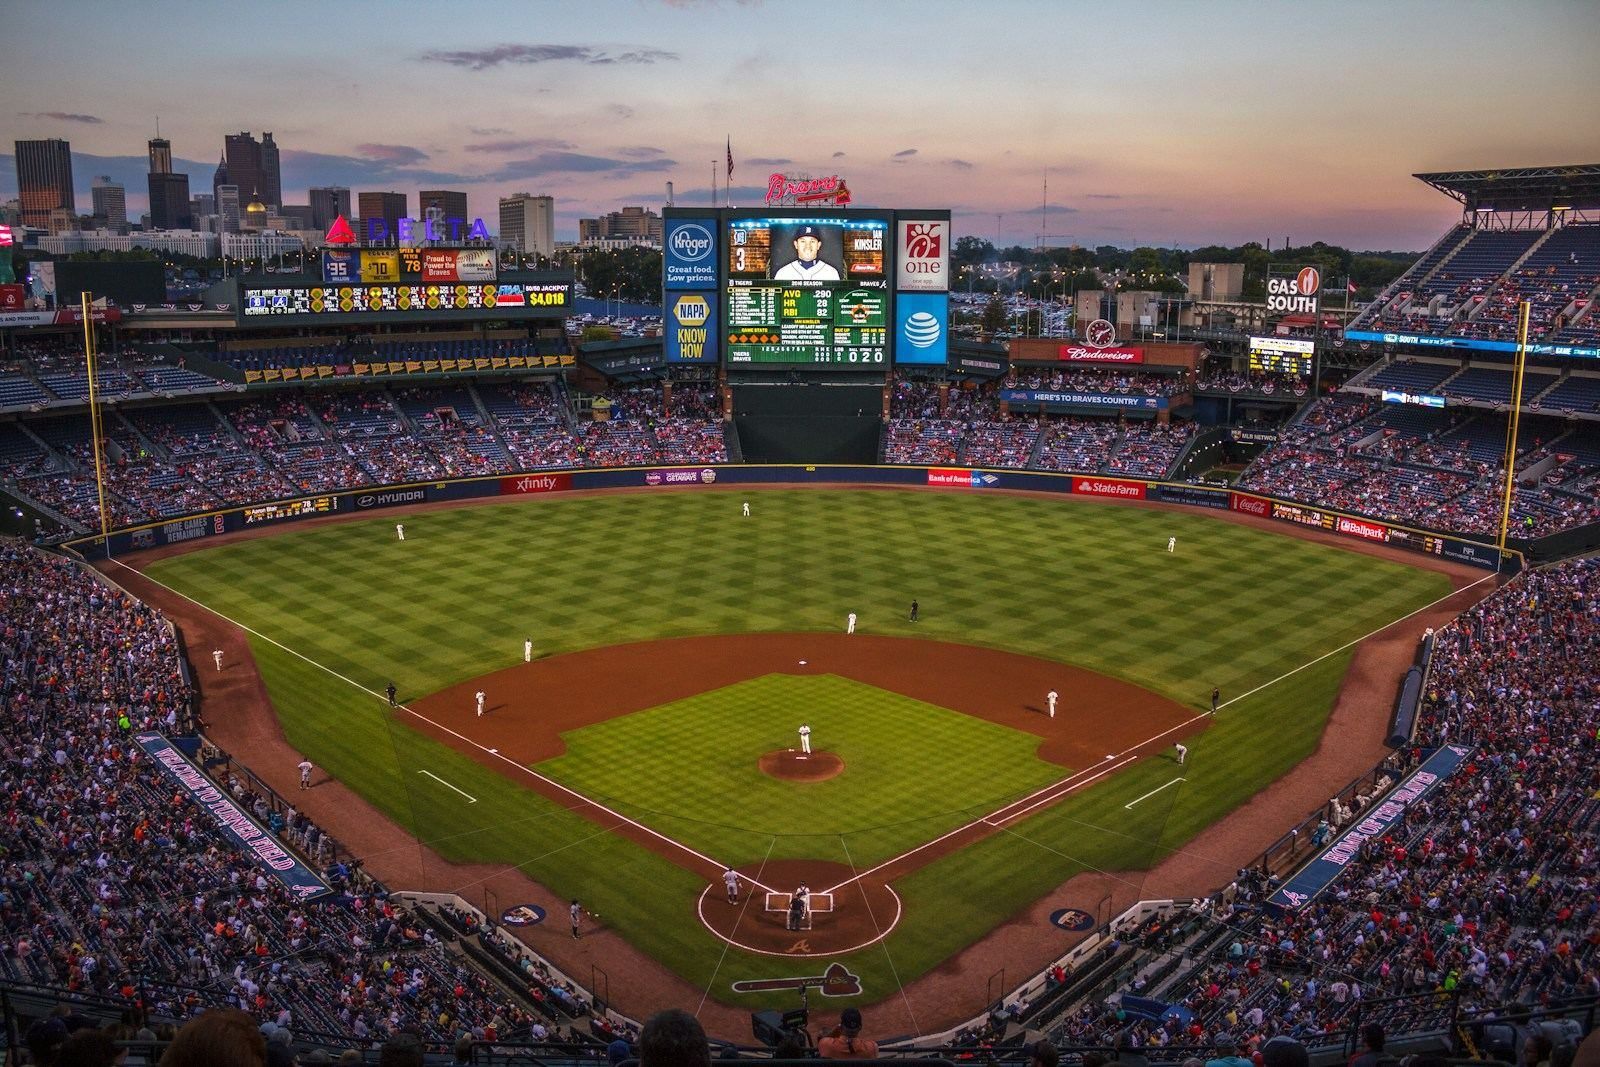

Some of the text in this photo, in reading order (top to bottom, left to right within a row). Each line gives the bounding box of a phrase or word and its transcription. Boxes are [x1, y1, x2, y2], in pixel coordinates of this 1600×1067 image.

[765, 173, 838, 204] Braves
[368, 218, 489, 240] DELTA
[872, 230, 882, 238] IAN
[674, 230, 708, 256] Kroger
[855, 239, 882, 250] KINSLER
[405, 260, 420, 272] 78
[736, 248, 745, 271] 3
[327, 263, 346, 276] $35
[368, 263, 387, 274] $70
[906, 262, 940, 273] one
[687, 274, 715, 283] prices.
[1268, 279, 1298, 295] GAS
[530, 293, 564, 306] $4,018
[1267, 296, 1316, 313] SOUTH
[680, 304, 704, 318] NAPA
[678, 329, 706, 343] KNOW
[1399, 335, 1418, 344] SOUTH
[681, 344, 703, 358] HOW
[849, 352, 883, 362] 0 2 0
[1067, 348, 1134, 360] Budweiser
[517, 476, 556, 491] xfinity
[378, 491, 424, 504] HYUNDAI
[164, 515, 224, 534] HOME GAMES 2
[1350, 524, 1384, 538] Ballpark
[168, 528, 205, 543] REMAINING
[1391, 530, 1409, 538] Kinsler
[1445, 550, 1492, 565] NORTHSIDE HOSPITAL
[154, 748, 295, 870] WELCOME TO TURNER FIELD
[1321, 771, 1438, 865] HOME OF THE BRAVES
